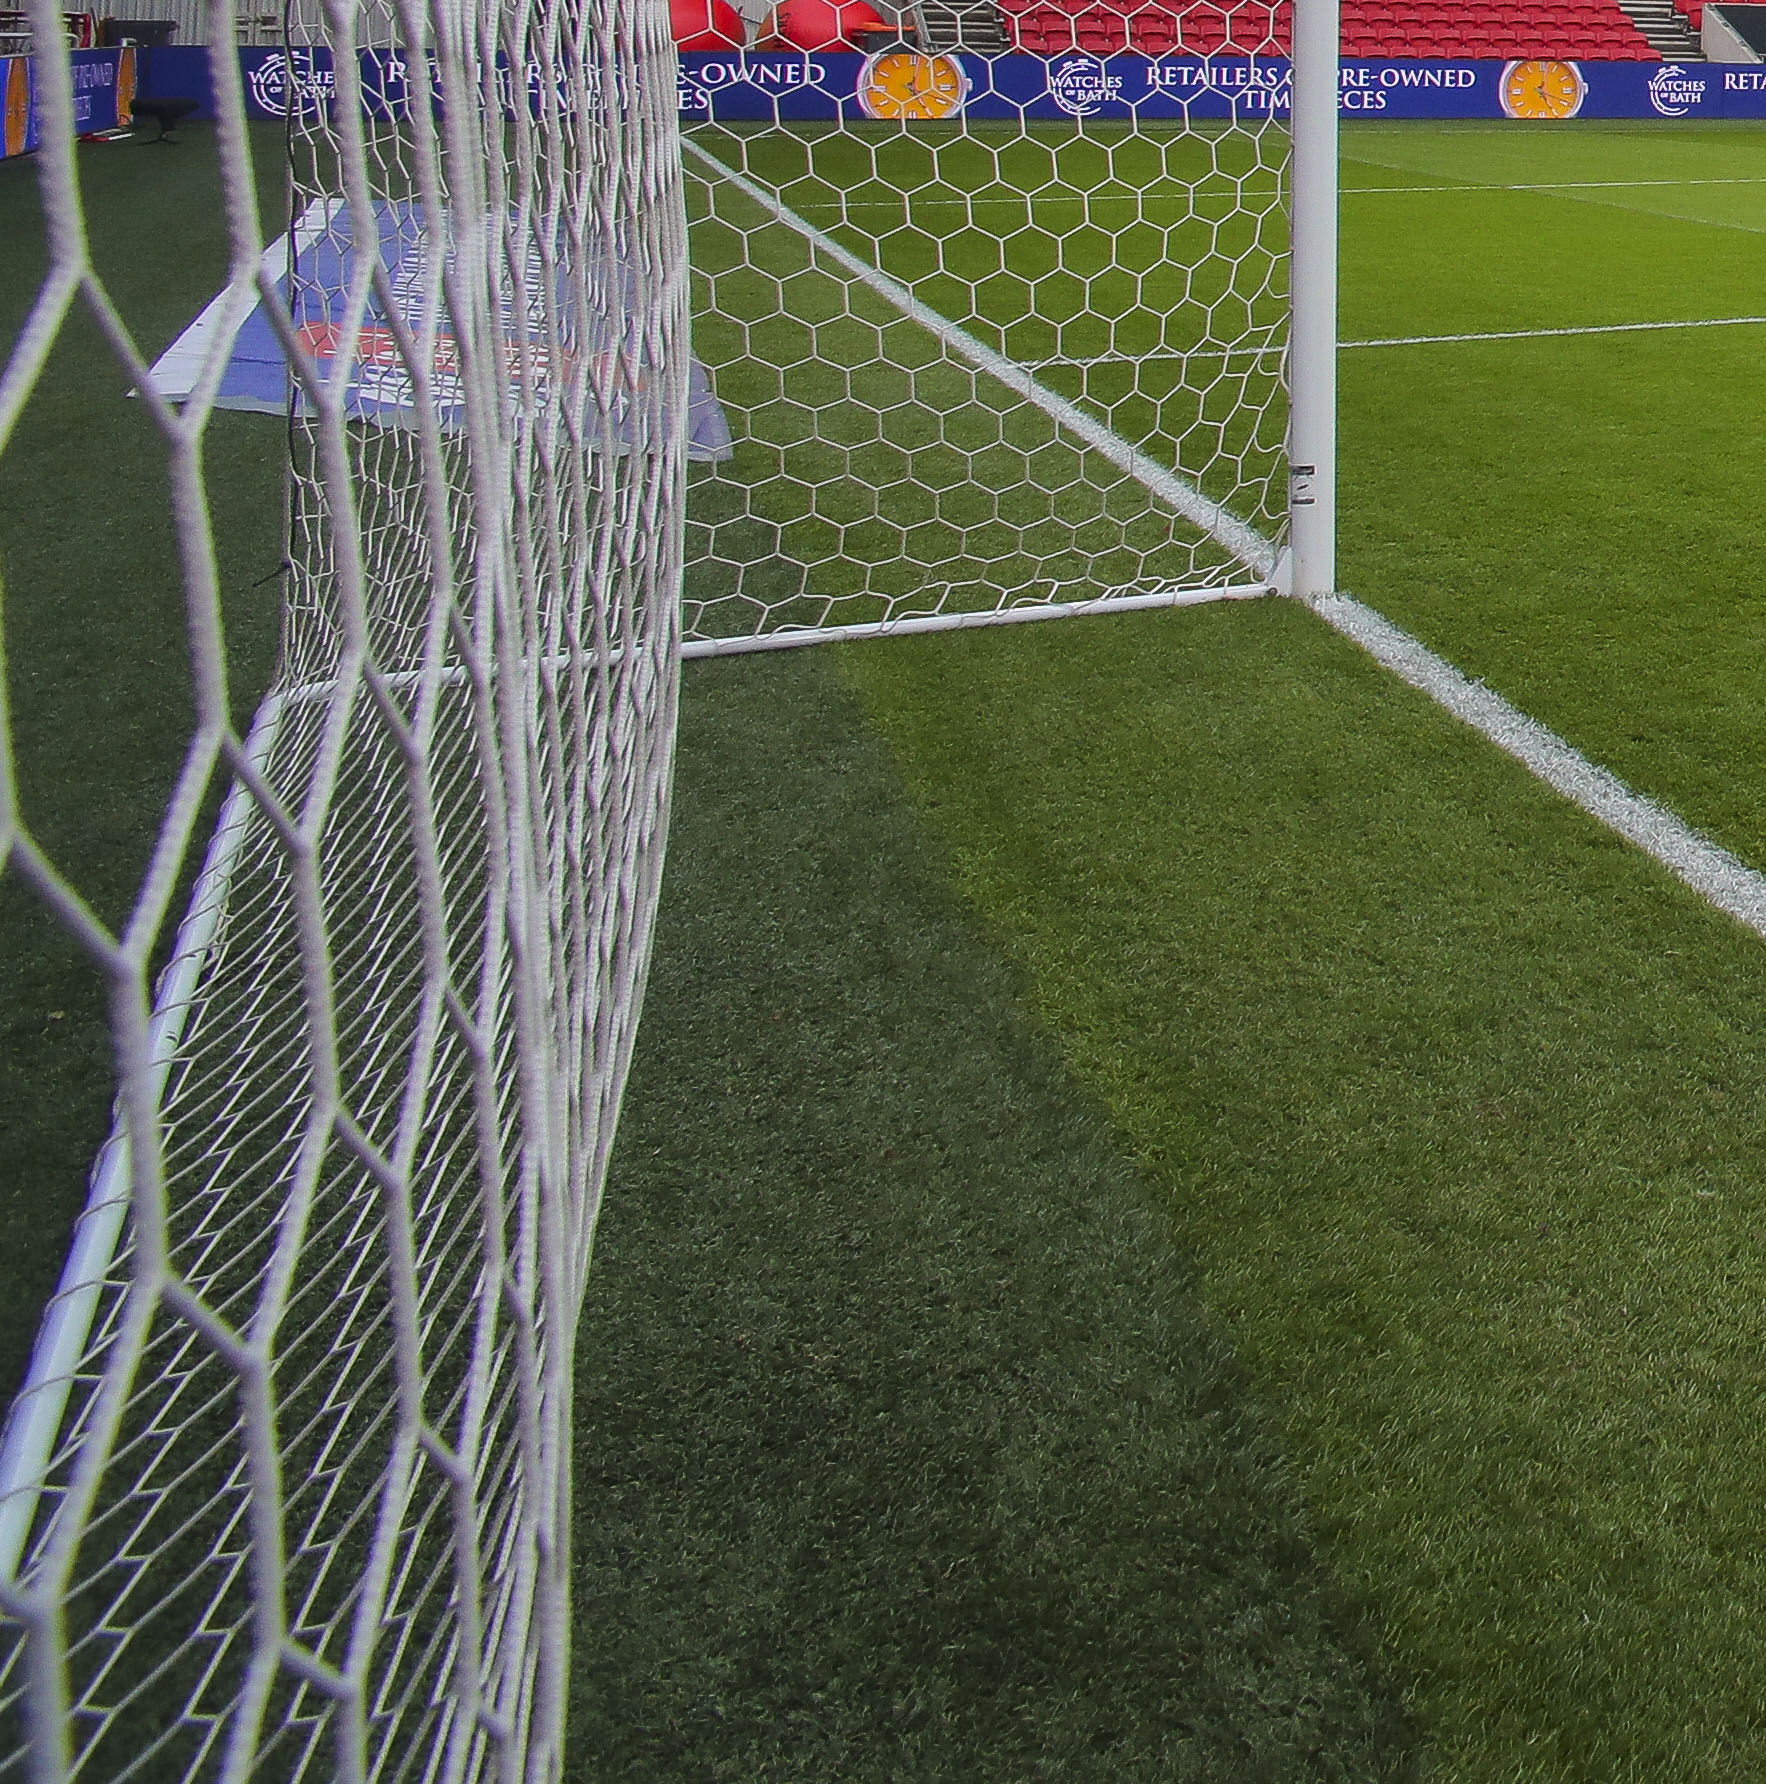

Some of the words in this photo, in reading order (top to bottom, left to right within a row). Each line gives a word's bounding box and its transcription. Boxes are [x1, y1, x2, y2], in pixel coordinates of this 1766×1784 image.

[248, 70, 337, 85] WATCHE
[1050, 76, 1122, 88] WATCHES
[1147, 67, 1278, 86] RETAILERS
[1337, 68, 1475, 88] RE-OWNED
[1648, 80, 1705, 92] WATCHES
[1077, 90, 1117, 101] BATH
[1670, 92, 1701, 103] BATH
